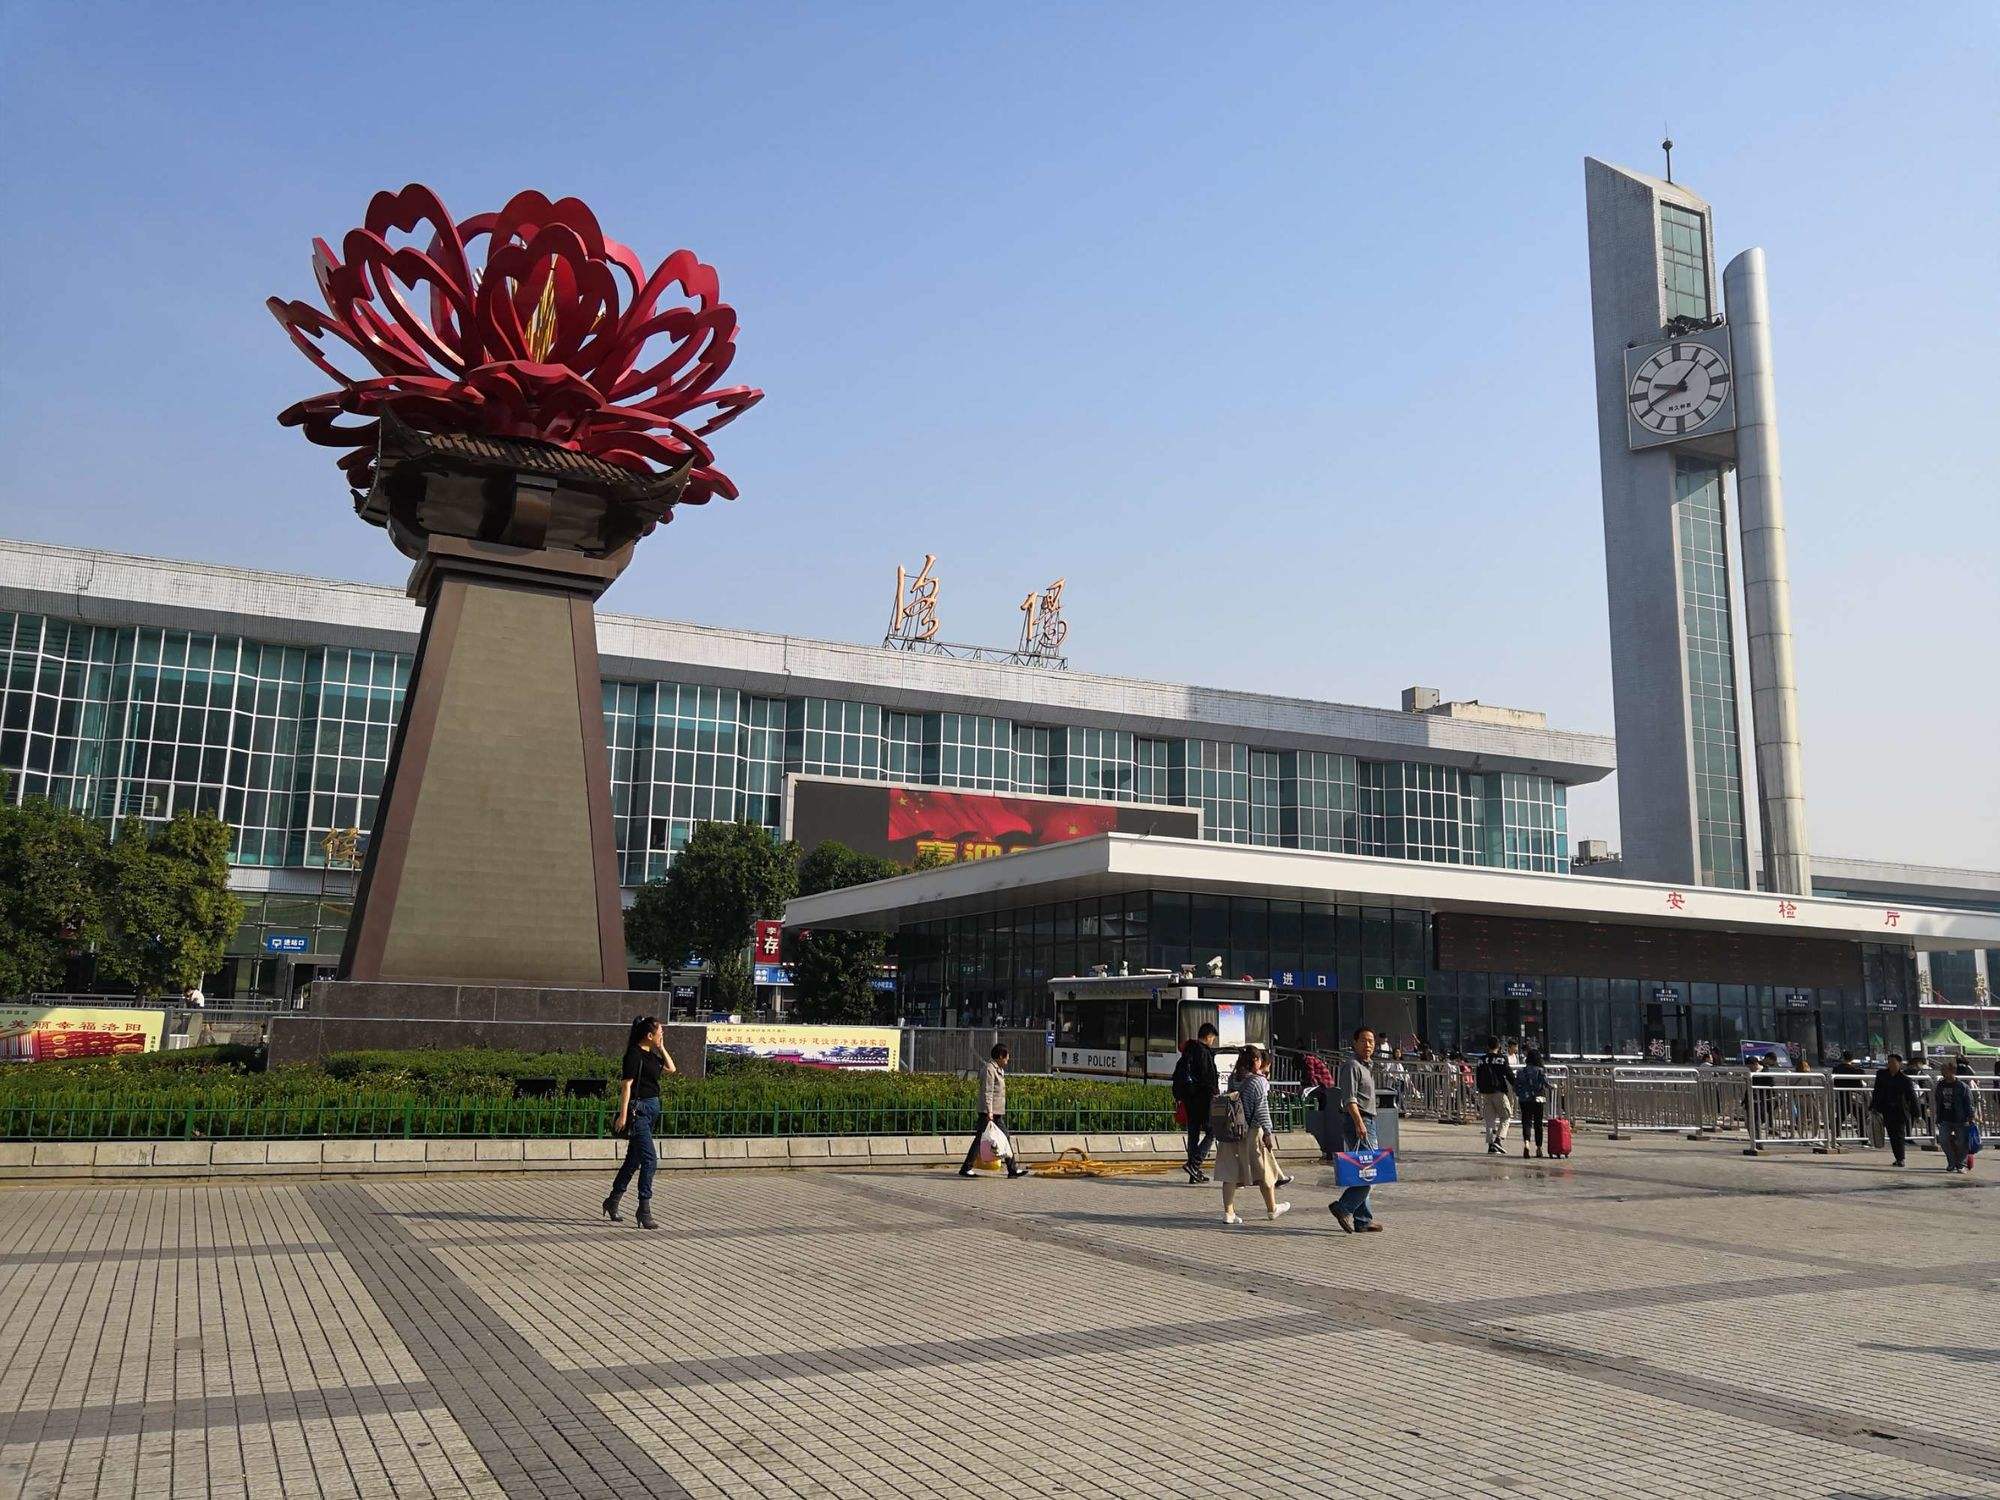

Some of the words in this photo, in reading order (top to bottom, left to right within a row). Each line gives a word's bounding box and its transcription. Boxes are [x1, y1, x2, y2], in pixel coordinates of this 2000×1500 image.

[1666, 890, 1901, 928] 安检厅
[1283, 972, 1327, 987] 进口
[1375, 976, 1416, 990] 出口
[0, 1019, 142, 1031] 美丽幸福洛阳
[1061, 1051, 1080, 1065] 警察
[1087, 1054, 1117, 1068] POLICE
